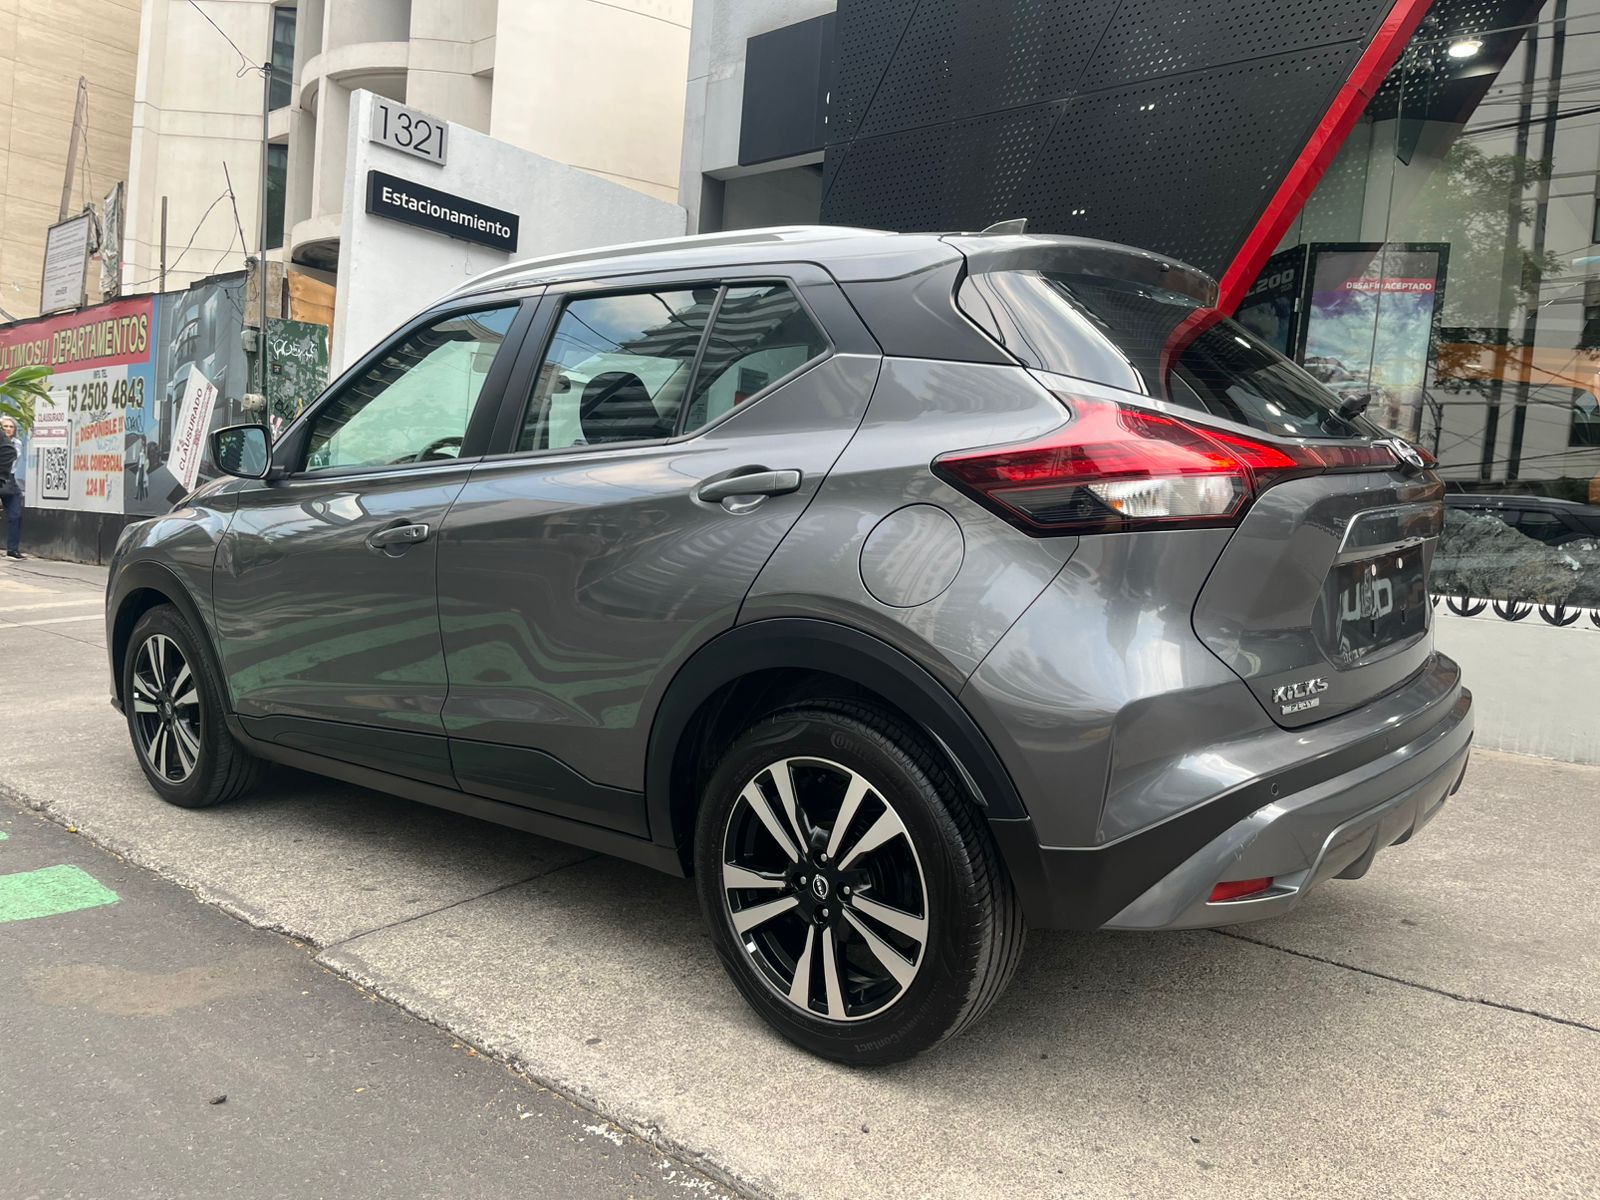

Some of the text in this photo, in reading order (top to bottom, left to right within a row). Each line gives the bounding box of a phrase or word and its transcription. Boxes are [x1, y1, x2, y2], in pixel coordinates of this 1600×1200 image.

[379, 105, 444, 159] 1321
[382, 186, 511, 239] Estacionamiento
[1384, 281, 1432, 290] ACEPTADO
[51, 313, 148, 366] DEPARTAMENTOS
[80, 381, 109, 412] 2508
[112, 377, 145, 409] 4843
[178, 387, 203, 471] CLAUSURADO
[73, 454, 123, 472] LOCAL COMERCIAL
[1272, 678, 1328, 703] KICKS
